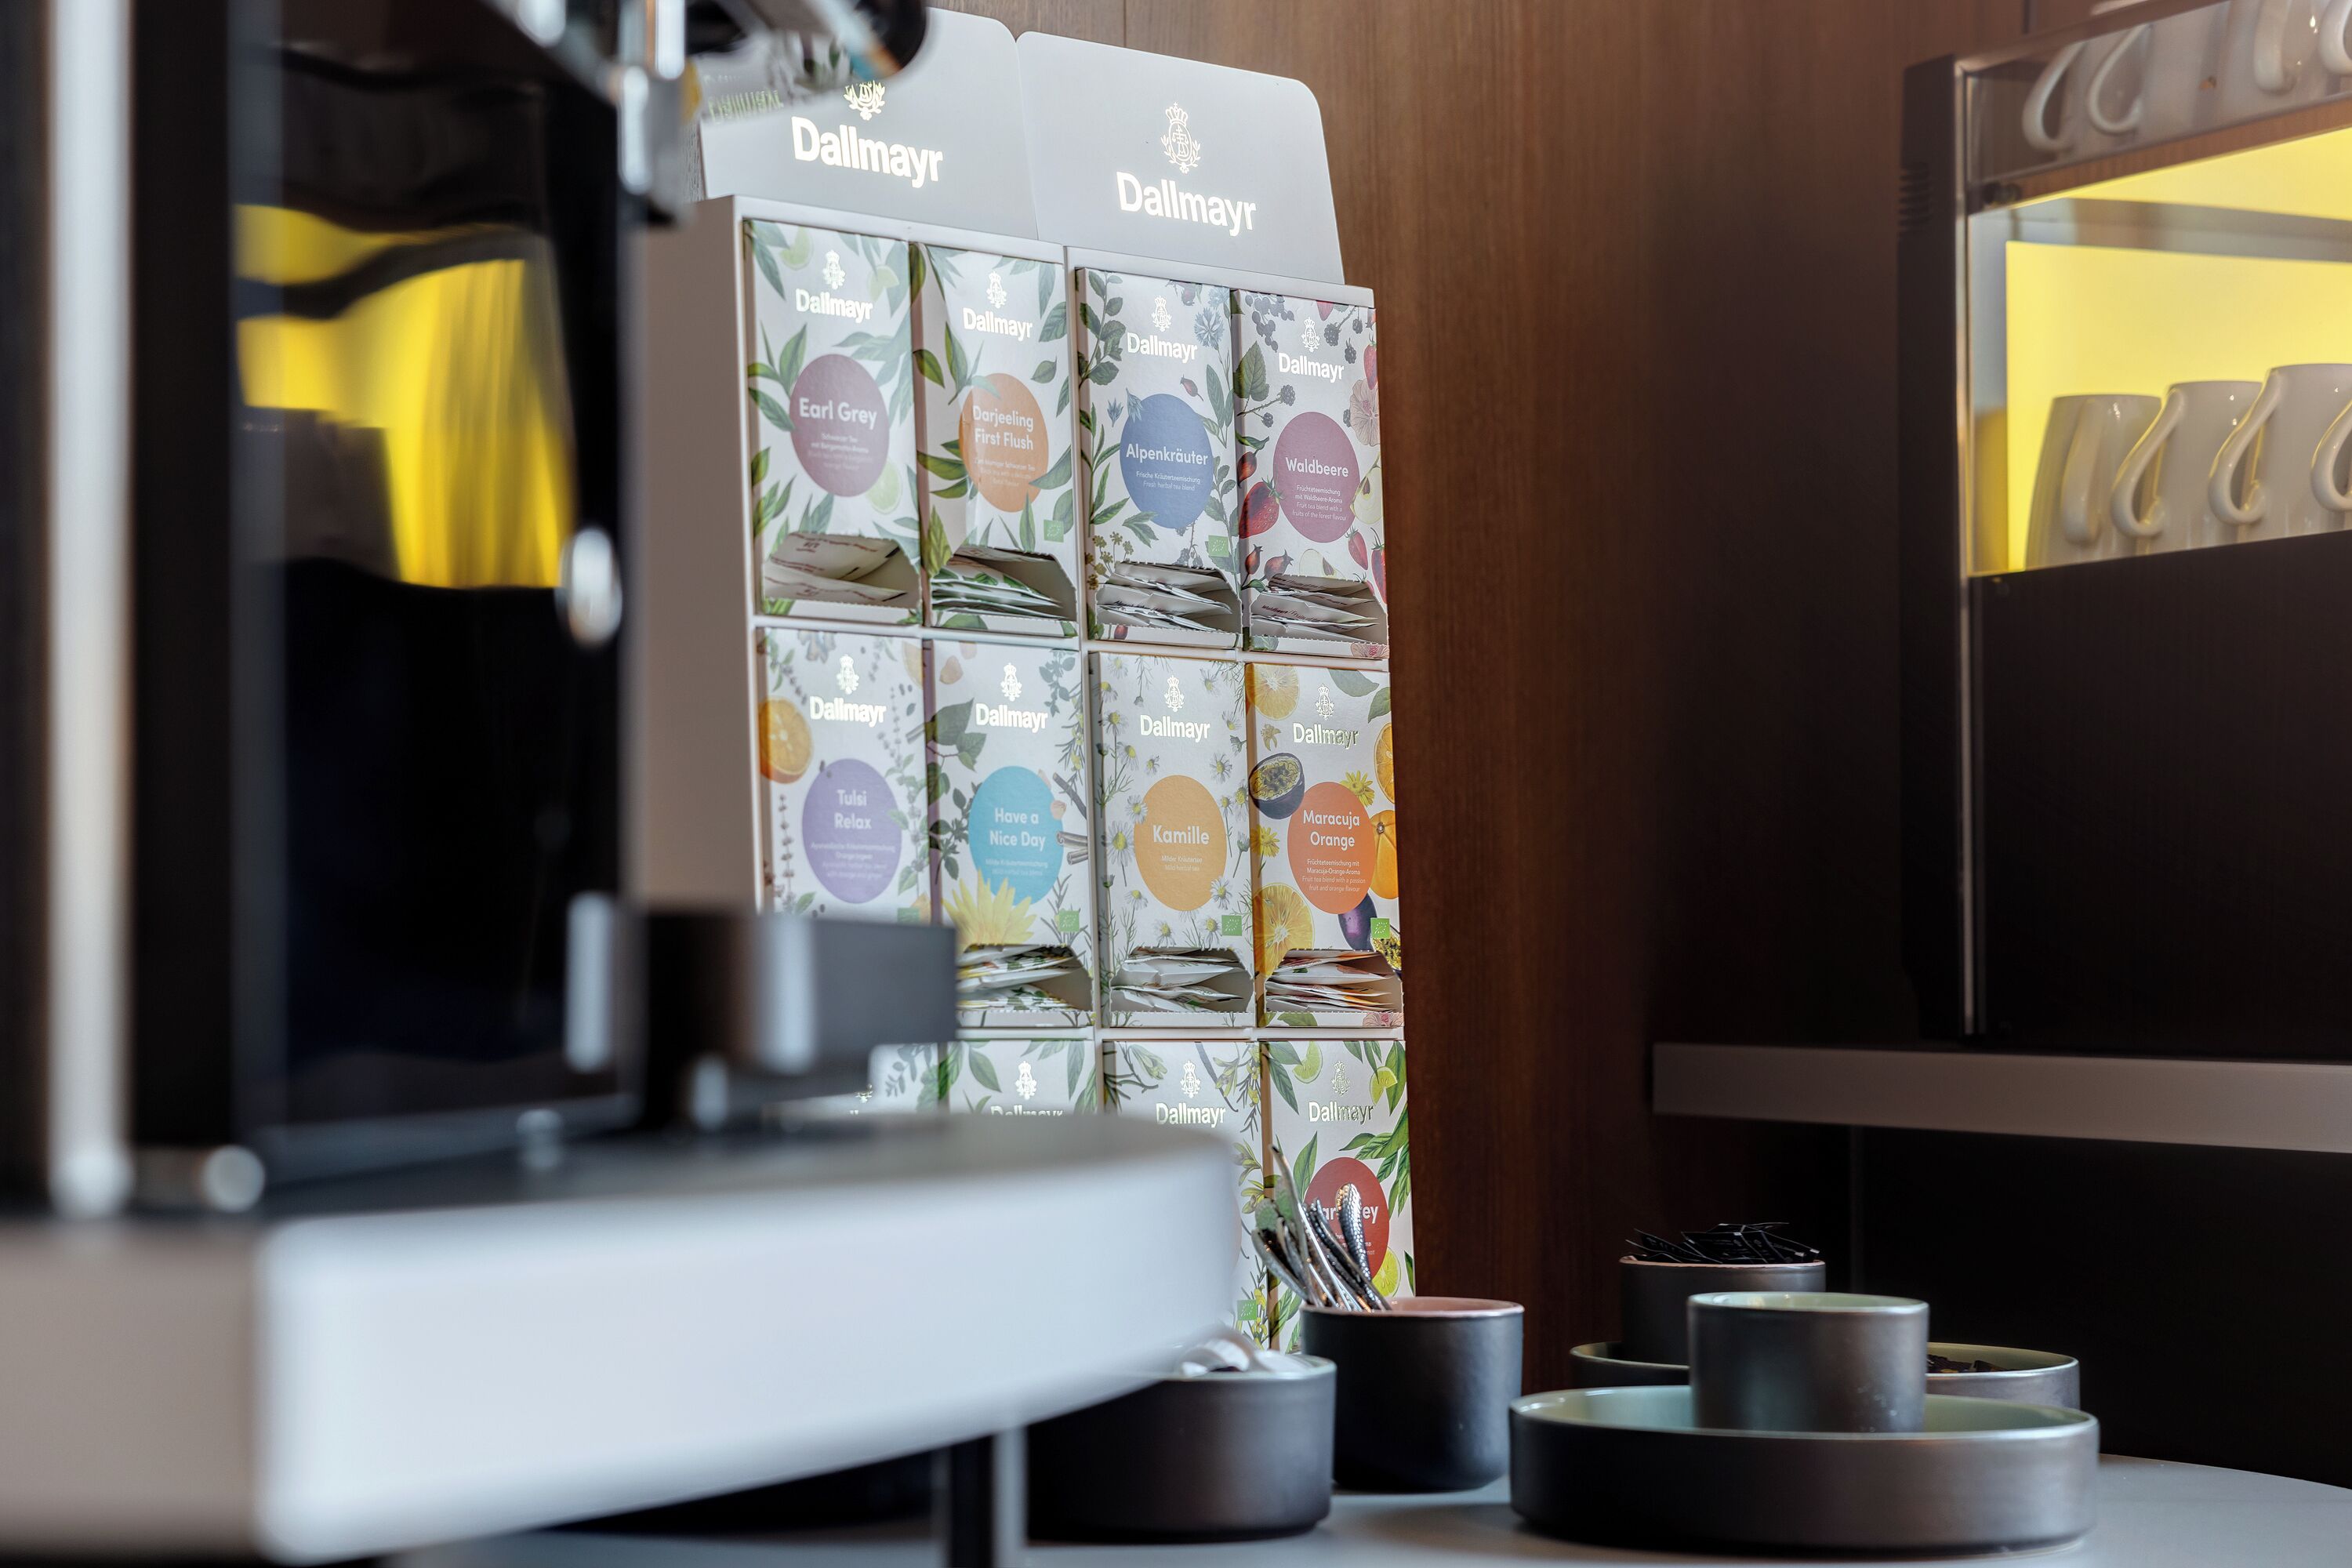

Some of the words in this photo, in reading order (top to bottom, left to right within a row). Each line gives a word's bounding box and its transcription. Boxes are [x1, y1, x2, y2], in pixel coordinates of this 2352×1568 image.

[791, 115, 943, 189] Dallmayr
[1116, 170, 1256, 238] Dallmayr
[795, 288, 873, 324] Dallmayr
[962, 307, 1033, 342] Dallmayr
[1127, 332, 1198, 364] Dallmayr
[1278, 352, 1345, 383] Dallmayr
[799, 397, 833, 420] Earl
[837, 401, 877, 430] Grey
[972, 405, 1034, 433] Darjeeling
[975, 427, 1000, 446] First
[1004, 431, 1034, 451] Flush
[1126, 443, 1208, 466] Alpenkräuter
[1286, 456, 1348, 477] Waldbeere
[1136, 470, 1154, 479] Frische
[808, 696, 887, 728] Dallmayr
[975, 703, 1048, 734] Dallmayr
[1139, 714, 1211, 743] Dallmayr
[1293, 723, 1359, 750] Dallmayr
[837, 789, 867, 806] Tulsi
[833, 812, 872, 829] Relax
[994, 808, 1028, 824] Have
[1030, 813, 1039, 824] a
[1303, 809, 1360, 829] Maracuja
[989, 830, 1018, 846] Nice
[1021, 831, 1046, 852] Day
[1152, 824, 1210, 845] Kamille
[1310, 831, 1355, 851] Orange
[1307, 858, 1352, 868] Früchteteemischung
[1156, 1102, 1226, 1128] Dallmayr
[1308, 1102, 1374, 1124] Dallmayr
